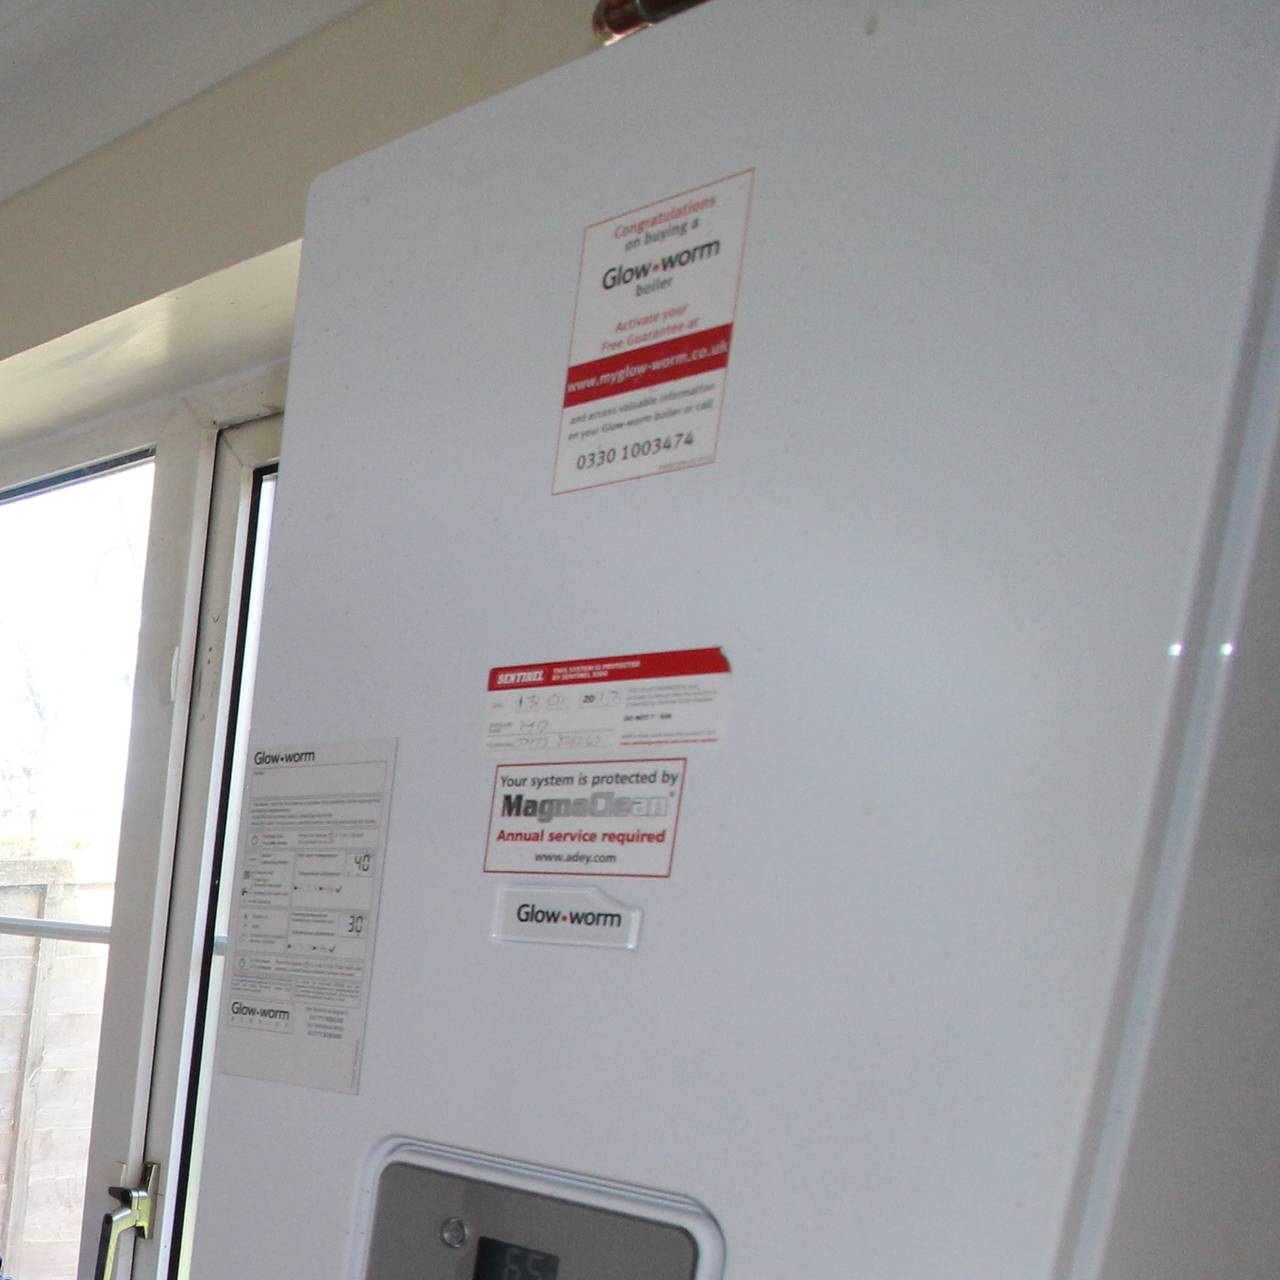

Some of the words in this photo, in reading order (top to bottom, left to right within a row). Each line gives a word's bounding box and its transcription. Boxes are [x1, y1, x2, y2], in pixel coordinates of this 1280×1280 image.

[614, 196, 717, 240] Congratulations
[625, 238, 641, 251] on
[644, 221, 688, 247] buying
[692, 218, 699, 230] a
[635, 277, 673, 297] boiler
[615, 311, 660, 332] Activate
[662, 305, 688, 320] your
[601, 340, 624, 352] Free
[627, 321, 684, 345] Guarantee
[566, 340, 729, 393] www.myglow-worm.co.uk
[570, 412, 587, 425] and
[588, 406, 617, 420] access
[660, 383, 715, 400] information
[654, 407, 681, 421] boiler
[577, 448, 616, 470] 0330
[622, 431, 694, 461] 1003474
[500, 775, 527, 788] Your
[531, 775, 574, 789] system
[578, 772, 588, 785] is
[592, 770, 658, 788] protected
[662, 770, 679, 787] by
[496, 829, 544, 843] Annual
[547, 829, 597, 844] service
[602, 830, 667, 845] required
[535, 852, 617, 865] www.adey.com
